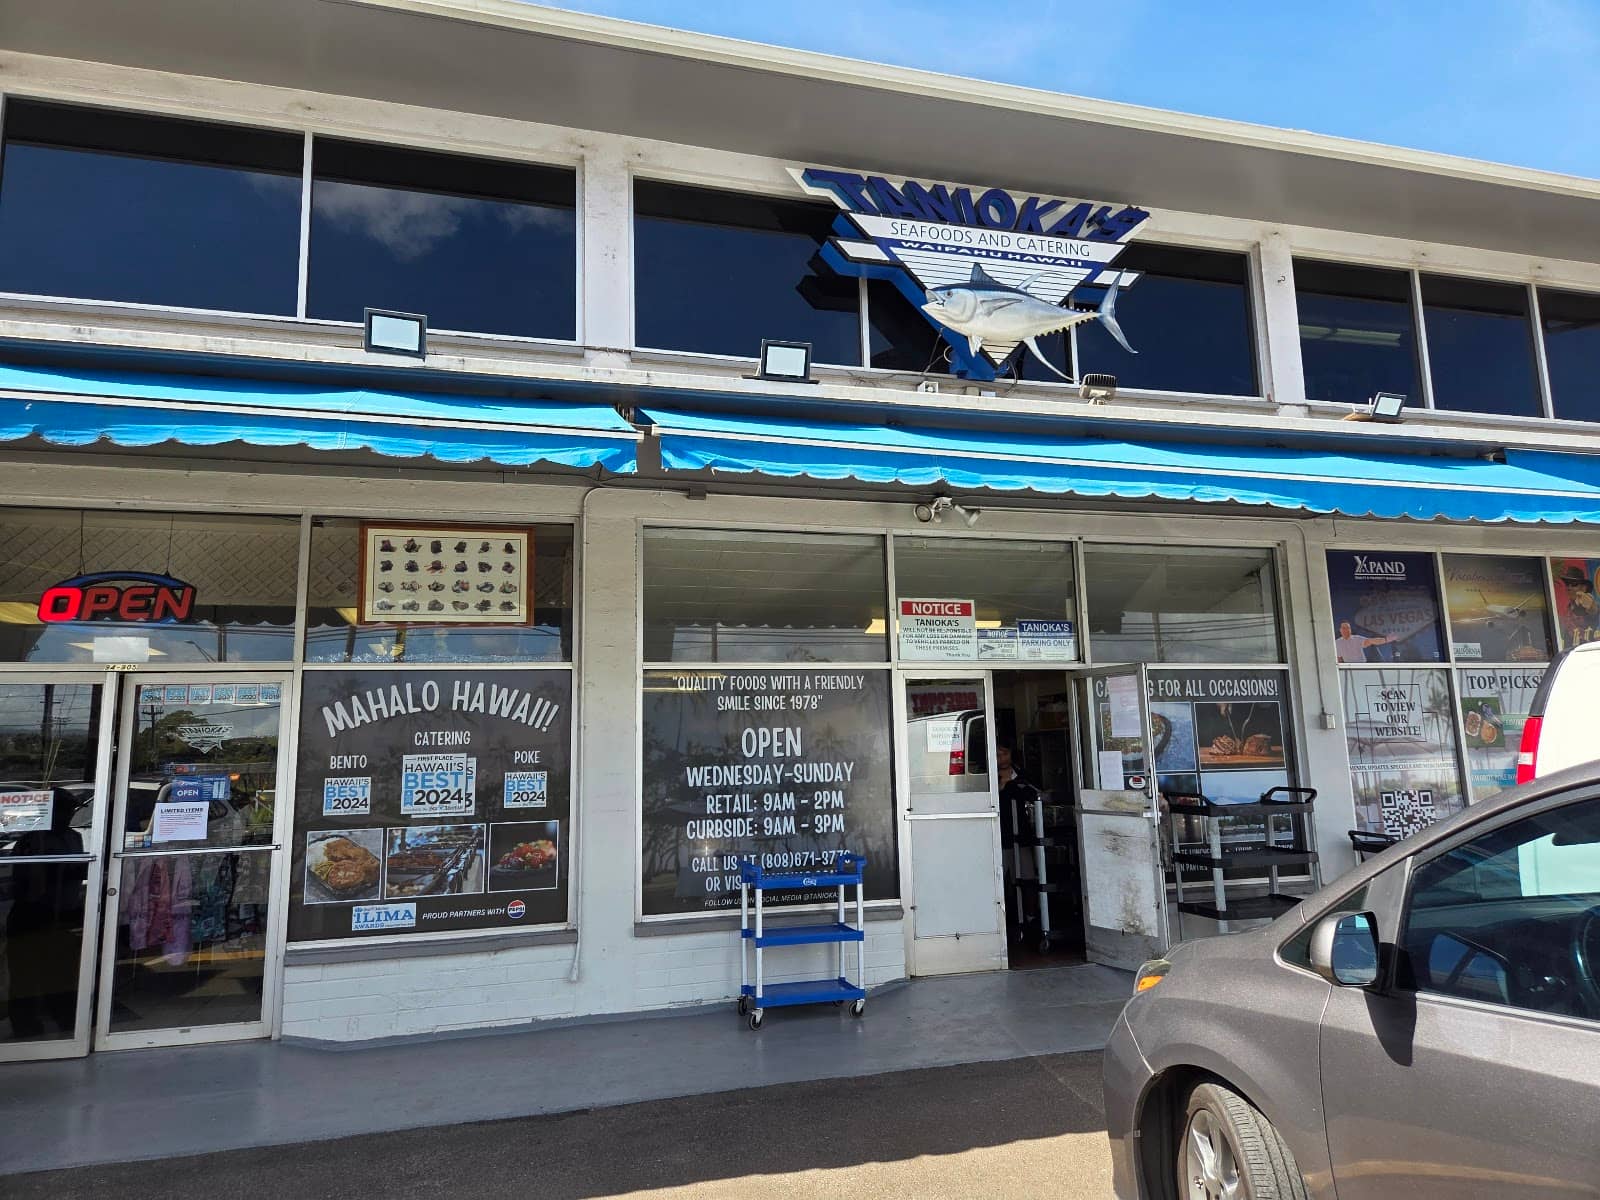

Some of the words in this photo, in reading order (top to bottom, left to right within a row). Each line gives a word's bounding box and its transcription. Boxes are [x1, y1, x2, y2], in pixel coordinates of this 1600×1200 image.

[802, 167, 1151, 242] TANIOKA'S
[890, 221, 973, 245] SEAFOODS
[979, 231, 1011, 249] AND
[1016, 236, 1090, 258] CATERING
[901, 240, 1003, 258] WAIPAHU
[1008, 252, 1083, 267] HAWAII
[1353, 555, 1406, 574] XPAND
[37, 586, 194, 622] OPEN
[912, 602, 962, 615] NOTICE
[915, 618, 960, 627] TANIOKA'S
[1021, 623, 1070, 632] TANIOKA'S
[1022, 639, 1051, 647] PARKING
[1053, 639, 1071, 647] ONLY
[730, 675, 767, 691] FOODS
[771, 675, 801, 690] WITH
[804, 676, 811, 690] A
[814, 675, 865, 690] FRIENDLY
[1158, 680, 1181, 698] FOR
[1185, 679, 1206, 697] ALL
[1209, 678, 1279, 696] OCCASIONS!
[1467, 675, 1495, 689] TOP
[1381, 689, 1407, 700] SCAN
[322, 680, 440, 738] MAHALO
[452, 680, 560, 732] HAWAII!
[717, 695, 751, 711] SMILE
[754, 695, 786, 711] SINCE
[790, 694, 823, 710] 1978"
[1374, 702, 1388, 712] TO
[1390, 701, 1416, 712] VIEW
[1386, 714, 1408, 724] OUR
[1375, 725, 1421, 737] WEBSITE!
[414, 731, 471, 746] CATERING
[741, 727, 802, 758] OPEN
[330, 755, 367, 769] BENTO
[514, 750, 541, 764] POKE
[405, 762, 464, 773] HAWAII'S
[686, 761, 854, 787] WEDNESDAY-SUNDAY
[326, 778, 369, 786] HAWAII'S
[404, 771, 464, 790] BEST
[506, 772, 546, 780] HAWAII'S
[326, 786, 368, 798] BEST
[506, 779, 543, 791] BEST
[1, 793, 50, 804] NOTICE
[177, 789, 199, 797] OPEN
[414, 788, 464, 806] 2024
[513, 791, 545, 802] 2024
[333, 797, 368, 809] 2024
[706, 794, 758, 814] RETAIL:
[763, 792, 795, 812] 9AM
[814, 790, 845, 809] 2PM
[160, 807, 184, 815] LIMITED
[686, 818, 758, 840] CURBSIDE:
[763, 815, 796, 836] 9AM
[814, 813, 845, 834] 3PM
[691, 855, 719, 873] CALL
[723, 854, 738, 871] US
[705, 876, 721, 892] OR
[705, 898, 735, 907] FOLLOW
[762, 895, 780, 903] OCIAL
[781, 893, 802, 902] MEDIA
[423, 911, 448, 920] PROUD
[449, 909, 486, 919] PARTNERS
[487, 907, 506, 916] WITH
